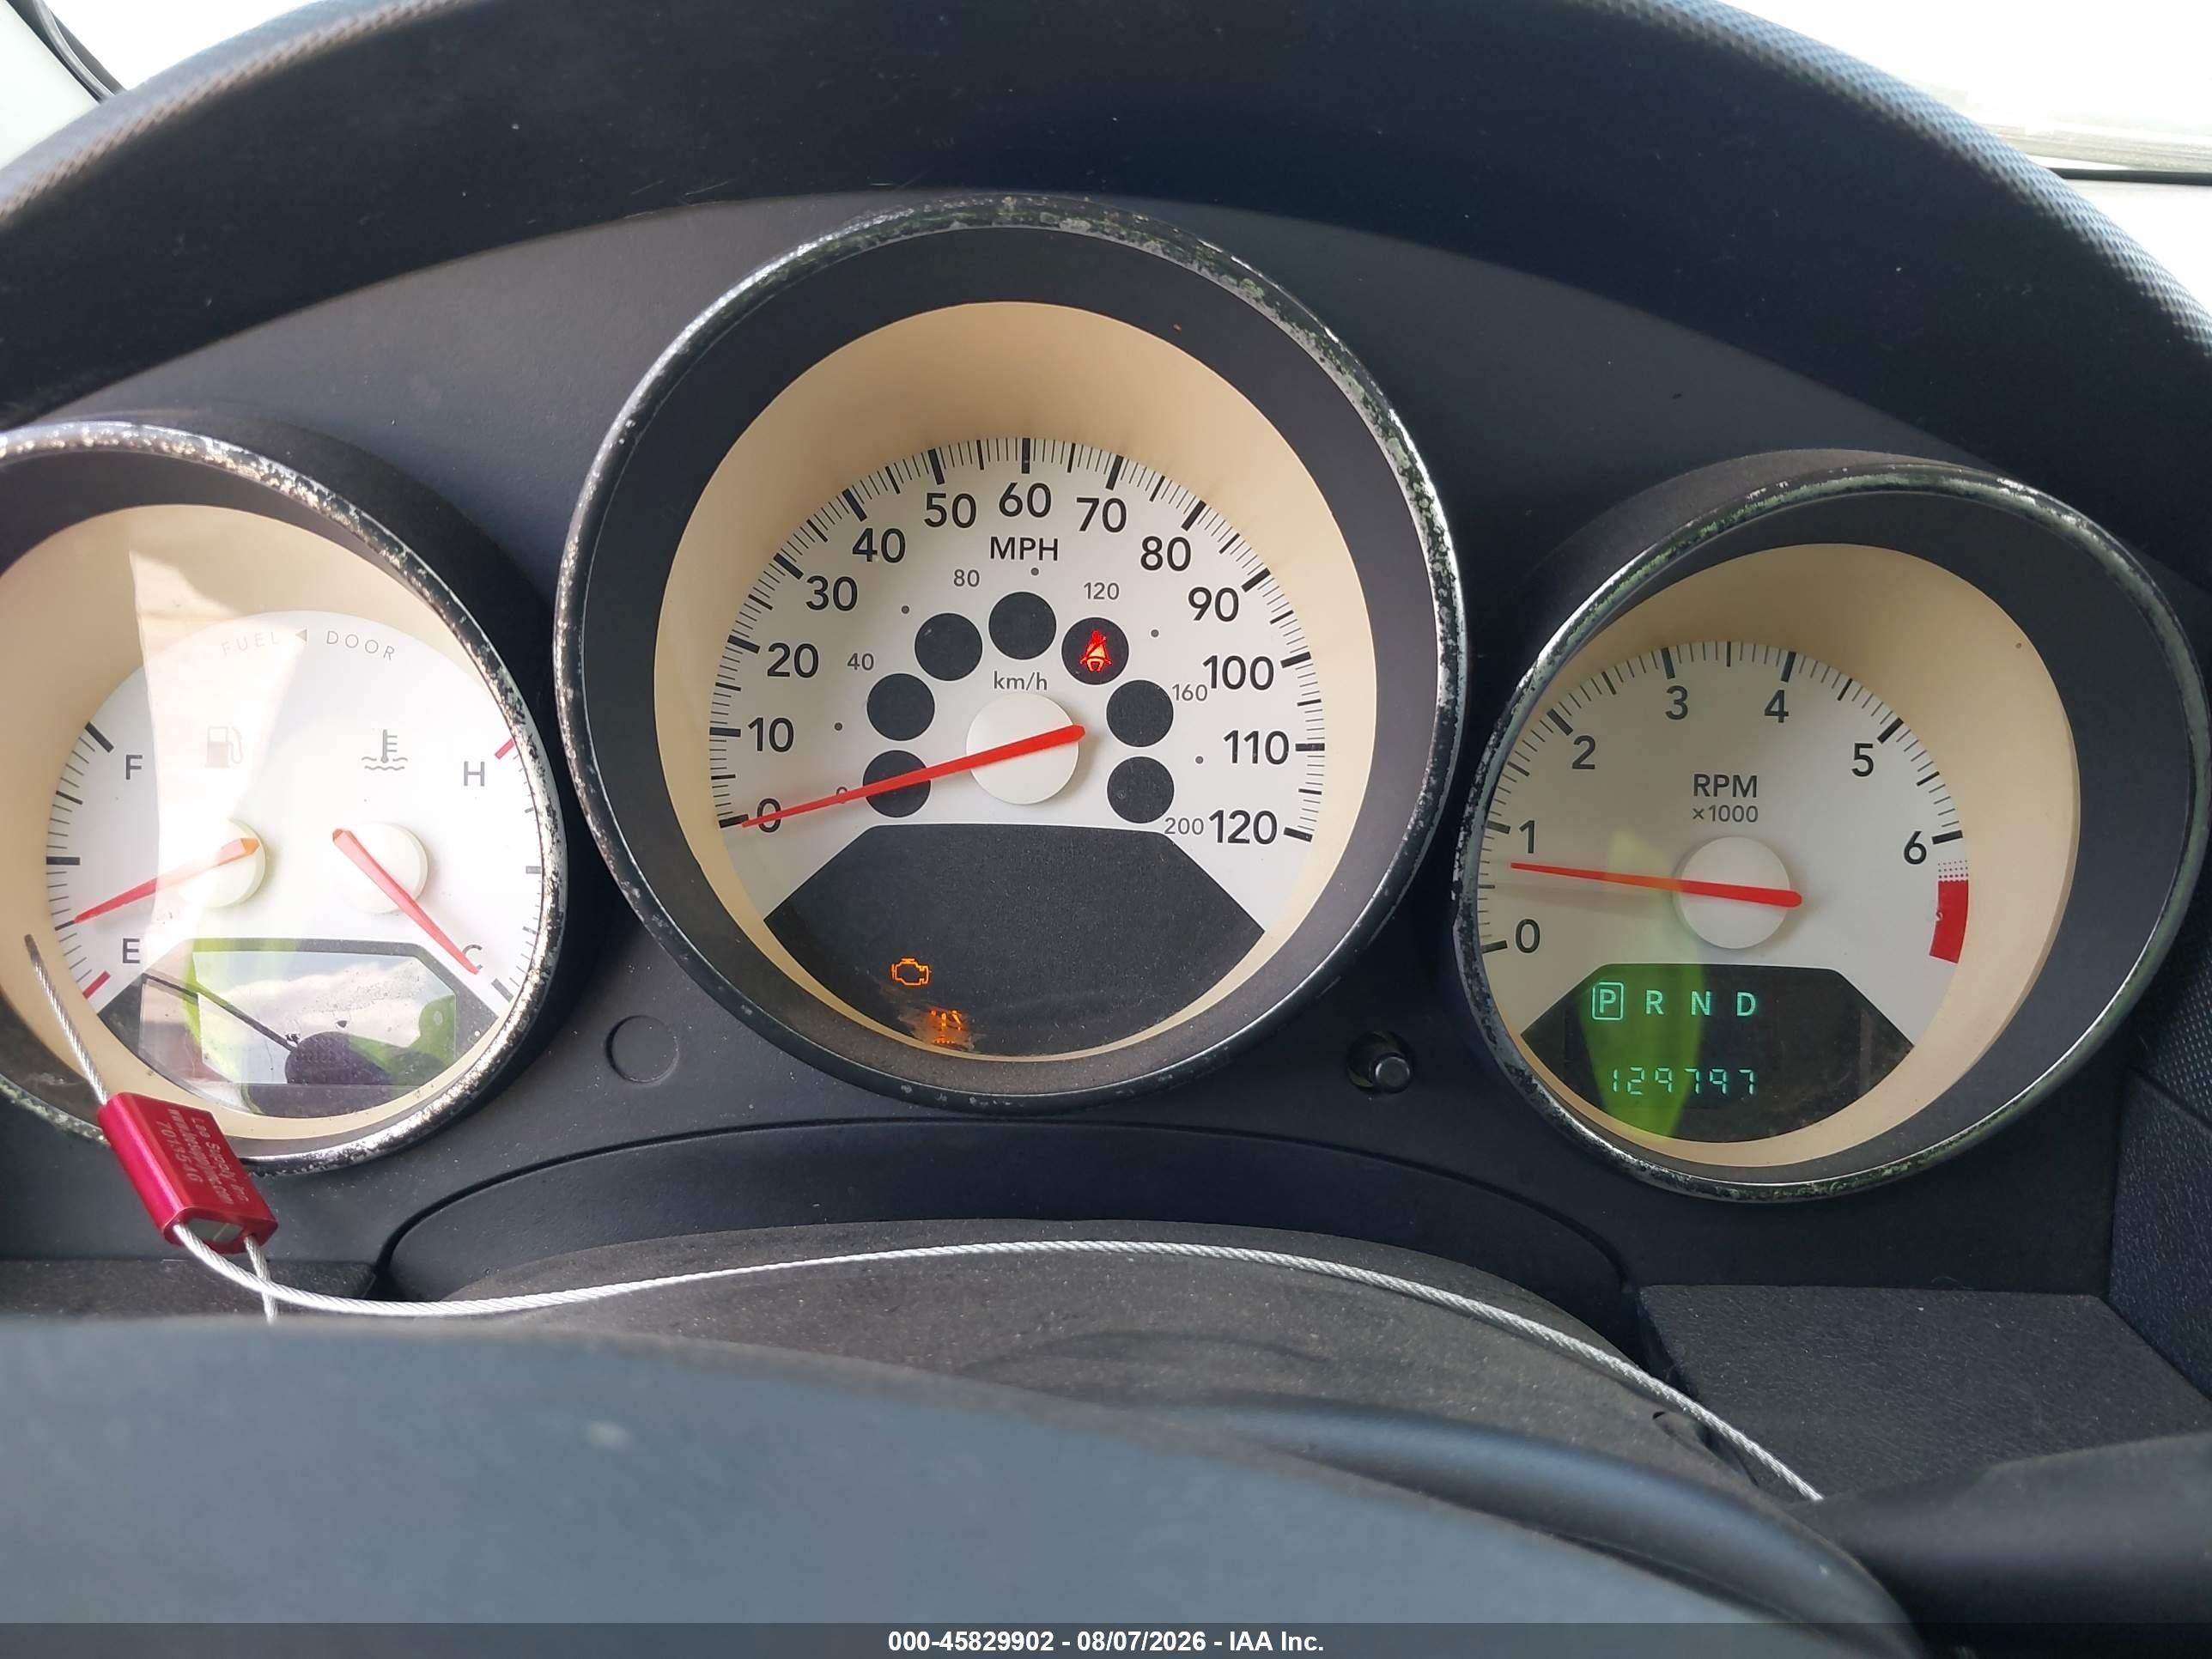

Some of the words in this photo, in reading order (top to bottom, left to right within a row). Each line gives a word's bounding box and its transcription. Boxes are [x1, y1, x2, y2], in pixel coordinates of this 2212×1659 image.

[923, 492, 977, 529] 50
[998, 482, 1052, 519] 60
[1076, 496, 1127, 533] 70
[852, 527, 906, 564] 40
[990, 536, 1059, 562] MPH
[1139, 535, 1192, 572] 80
[805, 574, 858, 611] 30
[953, 568, 981, 587] 80
[1083, 581, 1120, 600] 120
[1188, 586, 1239, 623] 90
[326, 629, 395, 660] DOOR
[767, 642, 819, 678] 20
[847, 652, 874, 672] 40
[993, 670, 1048, 691] km/h
[1203, 655, 1274, 691] 100
[1171, 684, 1208, 702] 160
[1665, 684, 1688, 720] 3
[1764, 689, 1790, 724] 4
[747, 717, 794, 753] 10
[1223, 730, 1290, 765] 110
[1571, 734, 1596, 770] 2
[125, 754, 143, 781] F
[463, 760, 485, 787] H
[1851, 742, 1875, 777] 5
[1693, 773, 1758, 799] RPM
[757, 798, 781, 833] 0
[1164, 817, 1205, 836] 200
[1208, 809, 1278, 845] 120
[1518, 819, 1535, 854] 1
[1903, 830, 1927, 866] 6
[122, 938, 141, 964] E
[1515, 918, 1540, 954] 0
[1598, 988, 1616, 1014] P
[1645, 989, 1664, 1015] R
[1691, 991, 1711, 1016] N
[1736, 992, 1756, 1017] D
[1611, 1066, 1756, 1095] 129797
